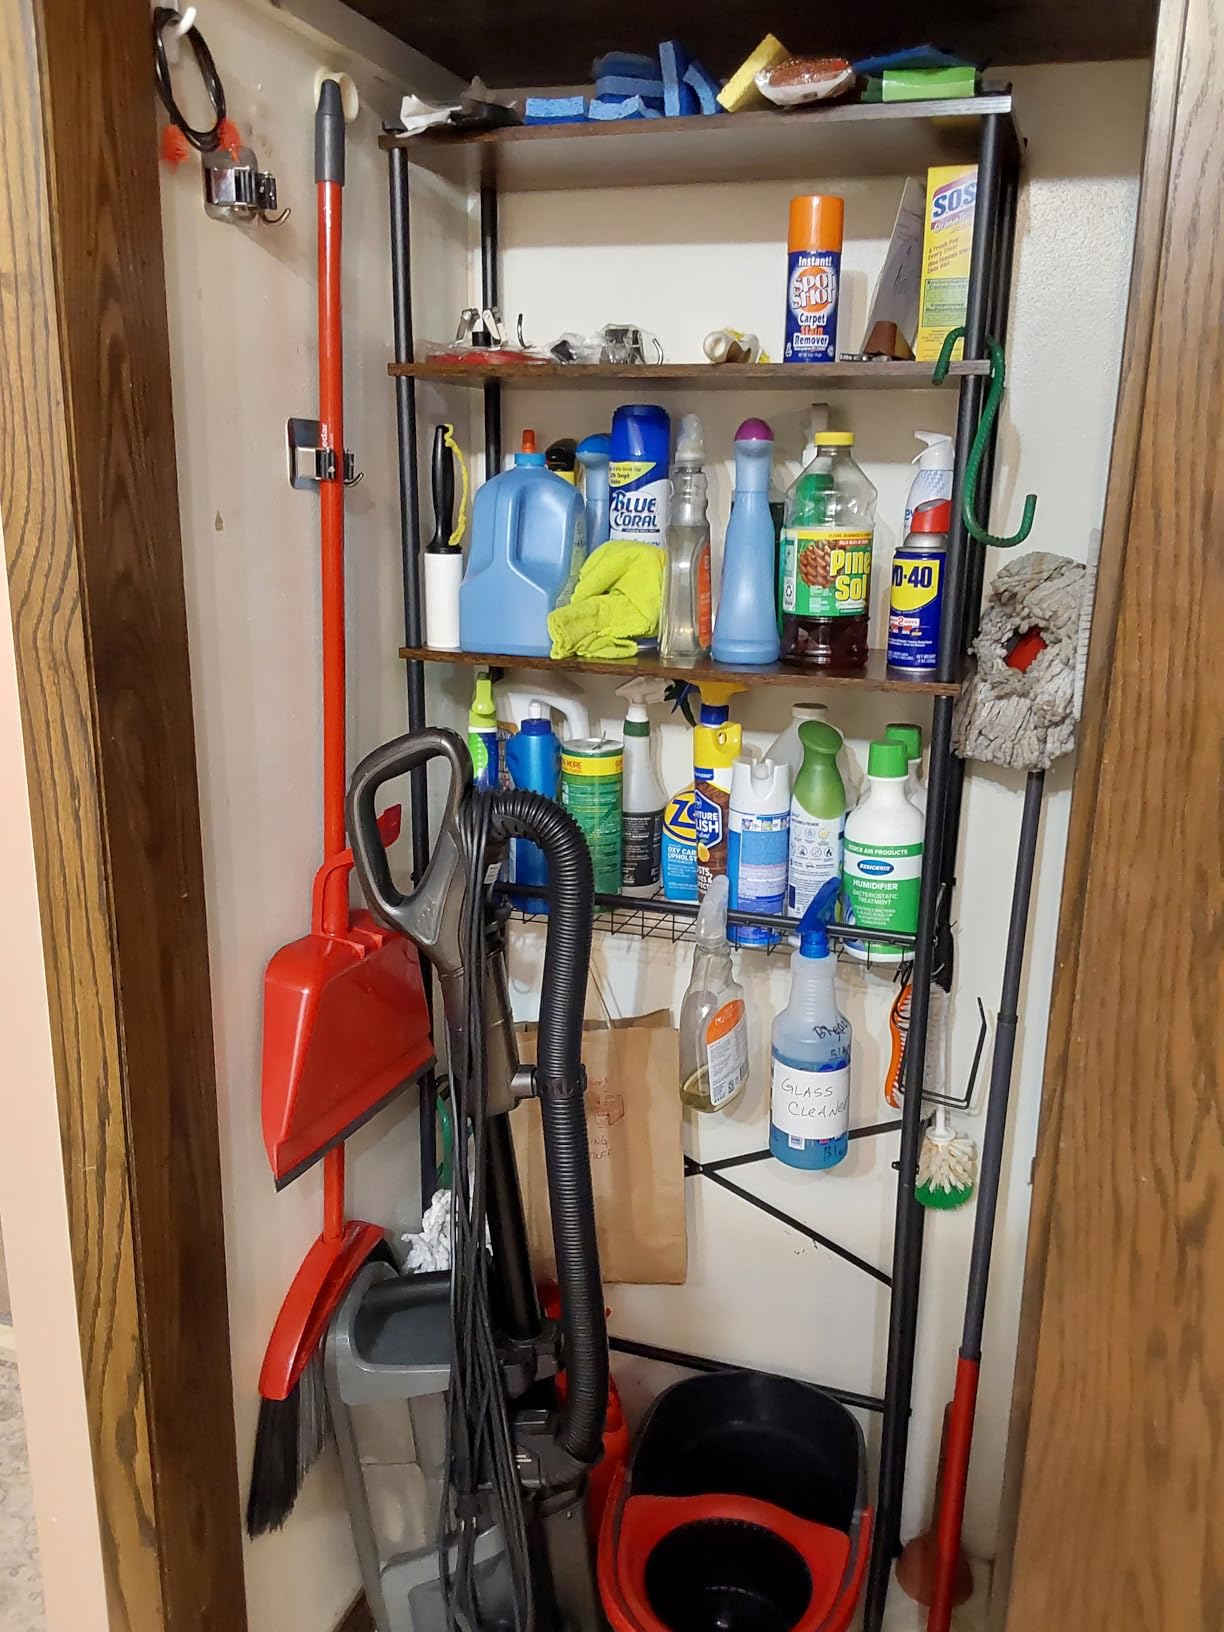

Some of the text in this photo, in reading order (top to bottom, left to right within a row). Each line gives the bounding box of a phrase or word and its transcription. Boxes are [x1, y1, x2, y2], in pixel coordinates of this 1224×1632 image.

[798, 256, 832, 266] Instant!
[793, 273, 836, 296] SPOT
[791, 288, 836, 309] SHOT
[799, 313, 825, 327] Carpet
[795, 335, 828, 345] Remover
[612, 491, 657, 513] BLUE
[614, 512, 658, 527] CORAL
[830, 549, 871, 577] Pine
[892, 565, 933, 589] D-40
[835, 574, 867, 601] Sol
[667, 852, 697, 862] UPHOLST
[668, 846, 680, 854] OXY
[853, 880, 898, 891] HUMIDIFIER
[852, 889, 898, 900] BACTERIOSTATIC
[858, 896, 891, 905] TREATMENT
[781, 1078, 833, 1098] GLASS
